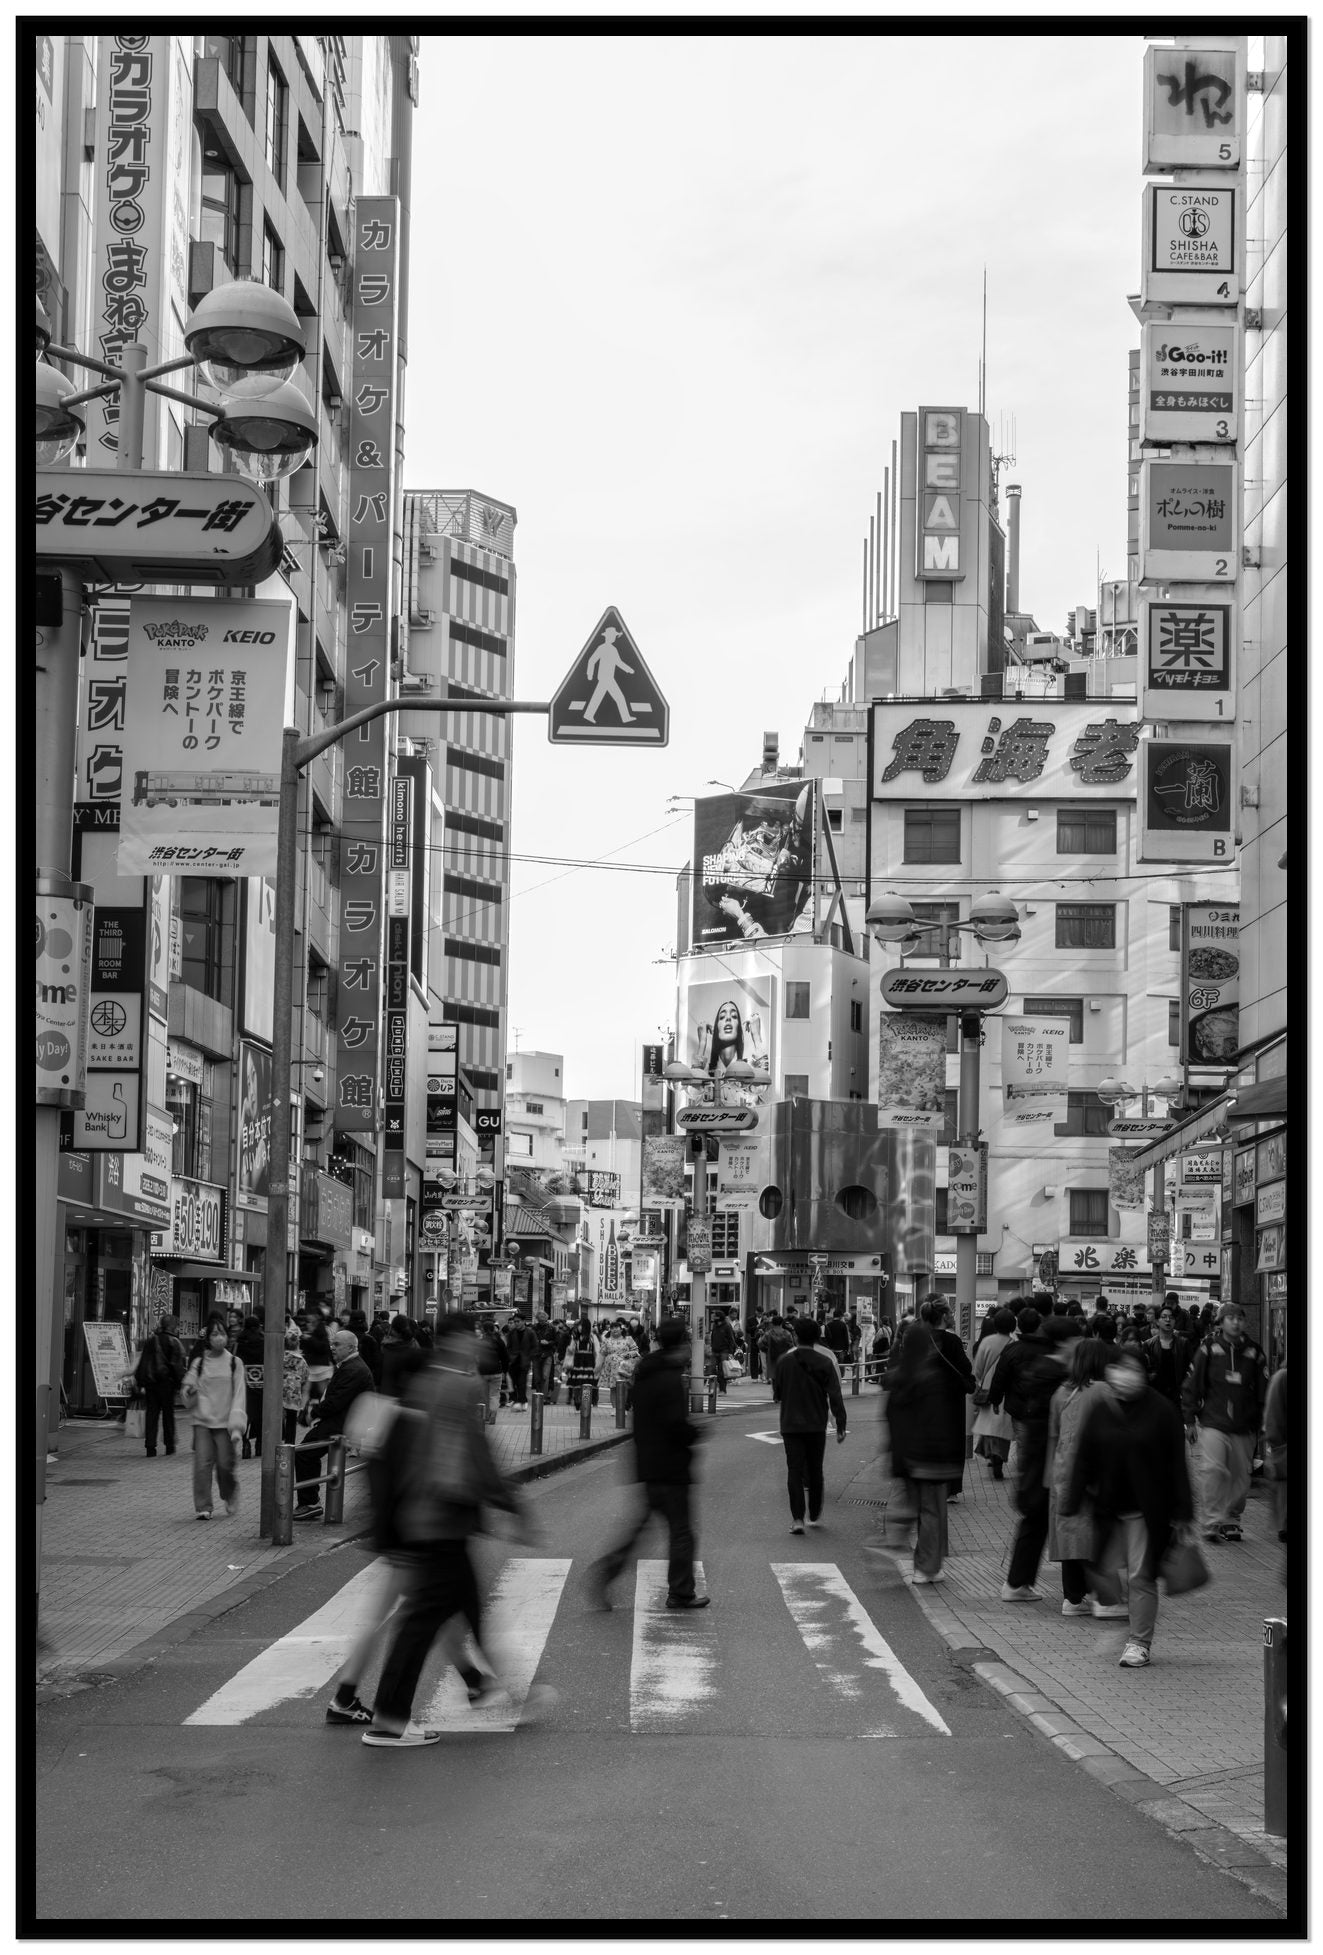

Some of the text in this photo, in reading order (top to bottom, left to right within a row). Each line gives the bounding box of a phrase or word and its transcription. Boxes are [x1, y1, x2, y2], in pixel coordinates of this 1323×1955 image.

[108, 51, 152, 201] カラオケ
[1219, 144, 1231, 160] 5
[1170, 195, 1219, 206] C.STAND
[1170, 239, 1219, 251] SHISHA
[1170, 252, 1219, 261] CAFE&BAR
[1216, 281, 1230, 298] 4
[1168, 346, 1228, 364] Goo-it!
[1161, 367, 1225, 378] 渋谷宇田川町店
[1155, 395, 1229, 408] 全身もみほぐし
[1216, 419, 1229, 438] 3
[924, 413, 959, 570] BEAM
[1156, 497, 1226, 519] ポムの樹
[1167, 524, 1217, 532] Pomme-no-ki
[1215, 558, 1228, 576] 2
[157, 639, 196, 647] KANTO
[223, 630, 276, 645] KEIO
[1160, 612, 1215, 668] 薬
[1153, 671, 1221, 686] マツモトキヨシ
[162, 668, 180, 716] 冒険へ
[182, 669, 202, 750] カントーの
[204, 669, 225, 751] ポケパーク
[228, 670, 247, 735] 京王線で
[1214, 699, 1224, 716] 1
[881, 716, 1142, 784] 角海老
[1154, 760, 1220, 812] 一蘭
[396, 782, 405, 863] kimono hearts
[149, 846, 246, 861] 渋谷センター街
[1213, 838, 1226, 856] B
[98, 959, 122, 967] ROOM
[102, 971, 118, 979] BAR
[340, 843, 377, 1107] カラオケ館
[889, 978, 1000, 993] 渋谷センター街
[1189, 988, 1221, 1009] 6F
[1042, 1028, 1065, 1036] KEIO
[47, 1041, 68, 1057] Day!
[85, 1111, 122, 1124] Whisky
[478, 1115, 500, 1128] GU
[680, 1112, 748, 1122] 渋谷センター街
[85, 1122, 107, 1132] Bank
[1111, 1122, 1174, 1133] 渋谷センター街
[1074, 1245, 1139, 1270] 兆楽
[607, 1244, 617, 1290] BEER
